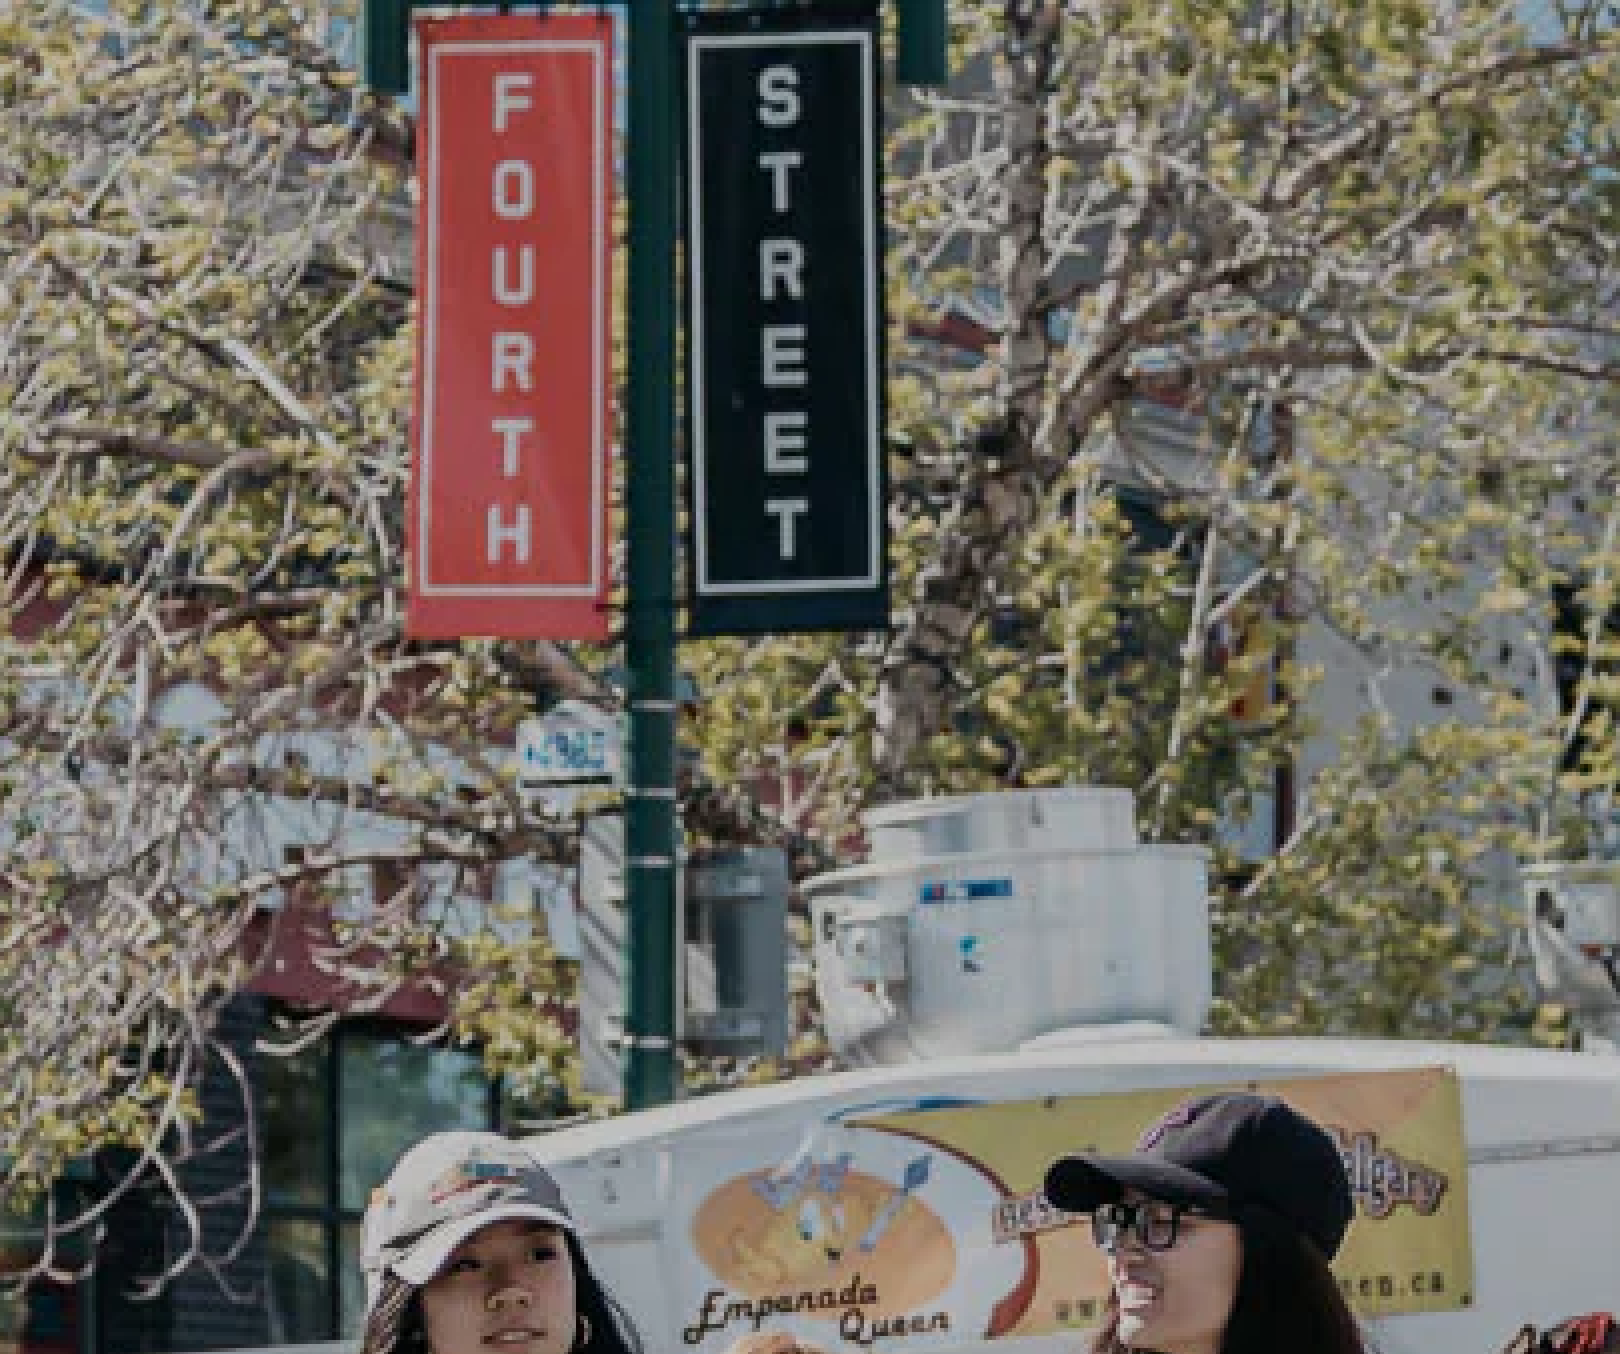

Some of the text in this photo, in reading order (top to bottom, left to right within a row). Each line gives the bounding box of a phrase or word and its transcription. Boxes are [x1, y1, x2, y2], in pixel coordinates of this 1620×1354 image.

[486, 71, 535, 565] FOURTH
[756, 64, 809, 562] STREET
[683, 1273, 878, 1345] Empanada
[839, 1307, 952, 1346] Queen
